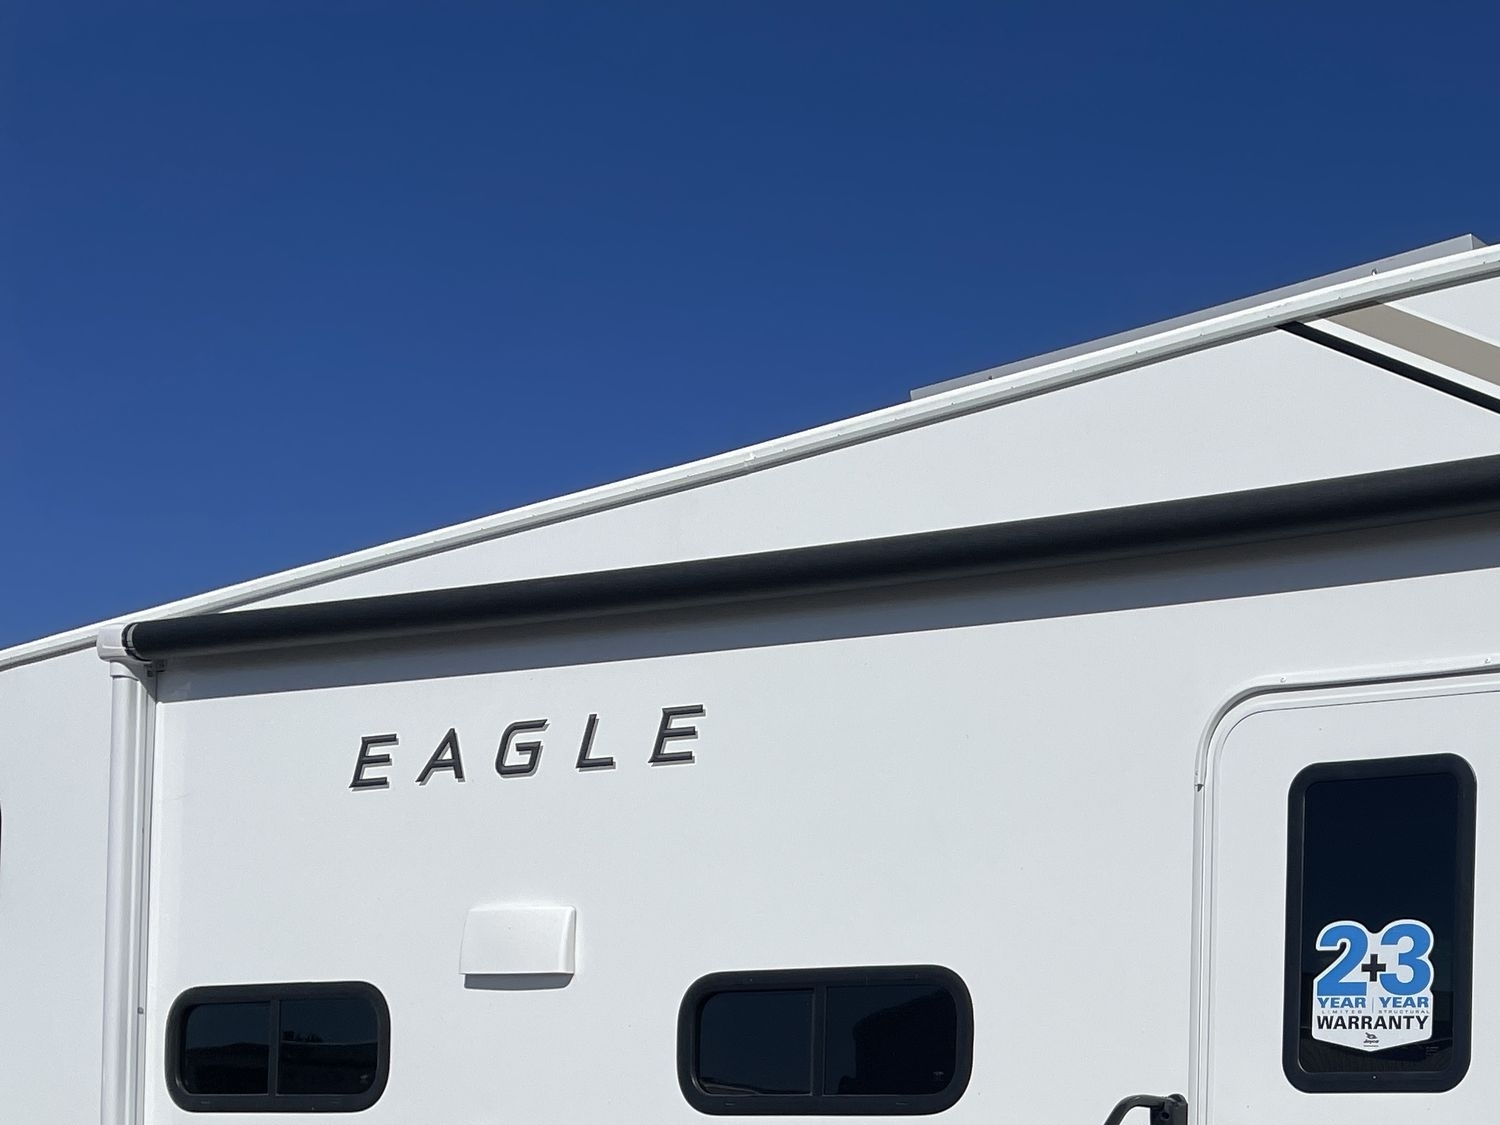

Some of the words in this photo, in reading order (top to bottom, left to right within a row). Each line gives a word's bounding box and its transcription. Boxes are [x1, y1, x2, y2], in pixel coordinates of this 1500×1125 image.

[349, 704, 706, 791] EAGLE
[1317, 997, 1366, 1008] YEAR
[1379, 996, 1429, 1008] YEAR
[1317, 1015, 1429, 1030] WARRANTY
